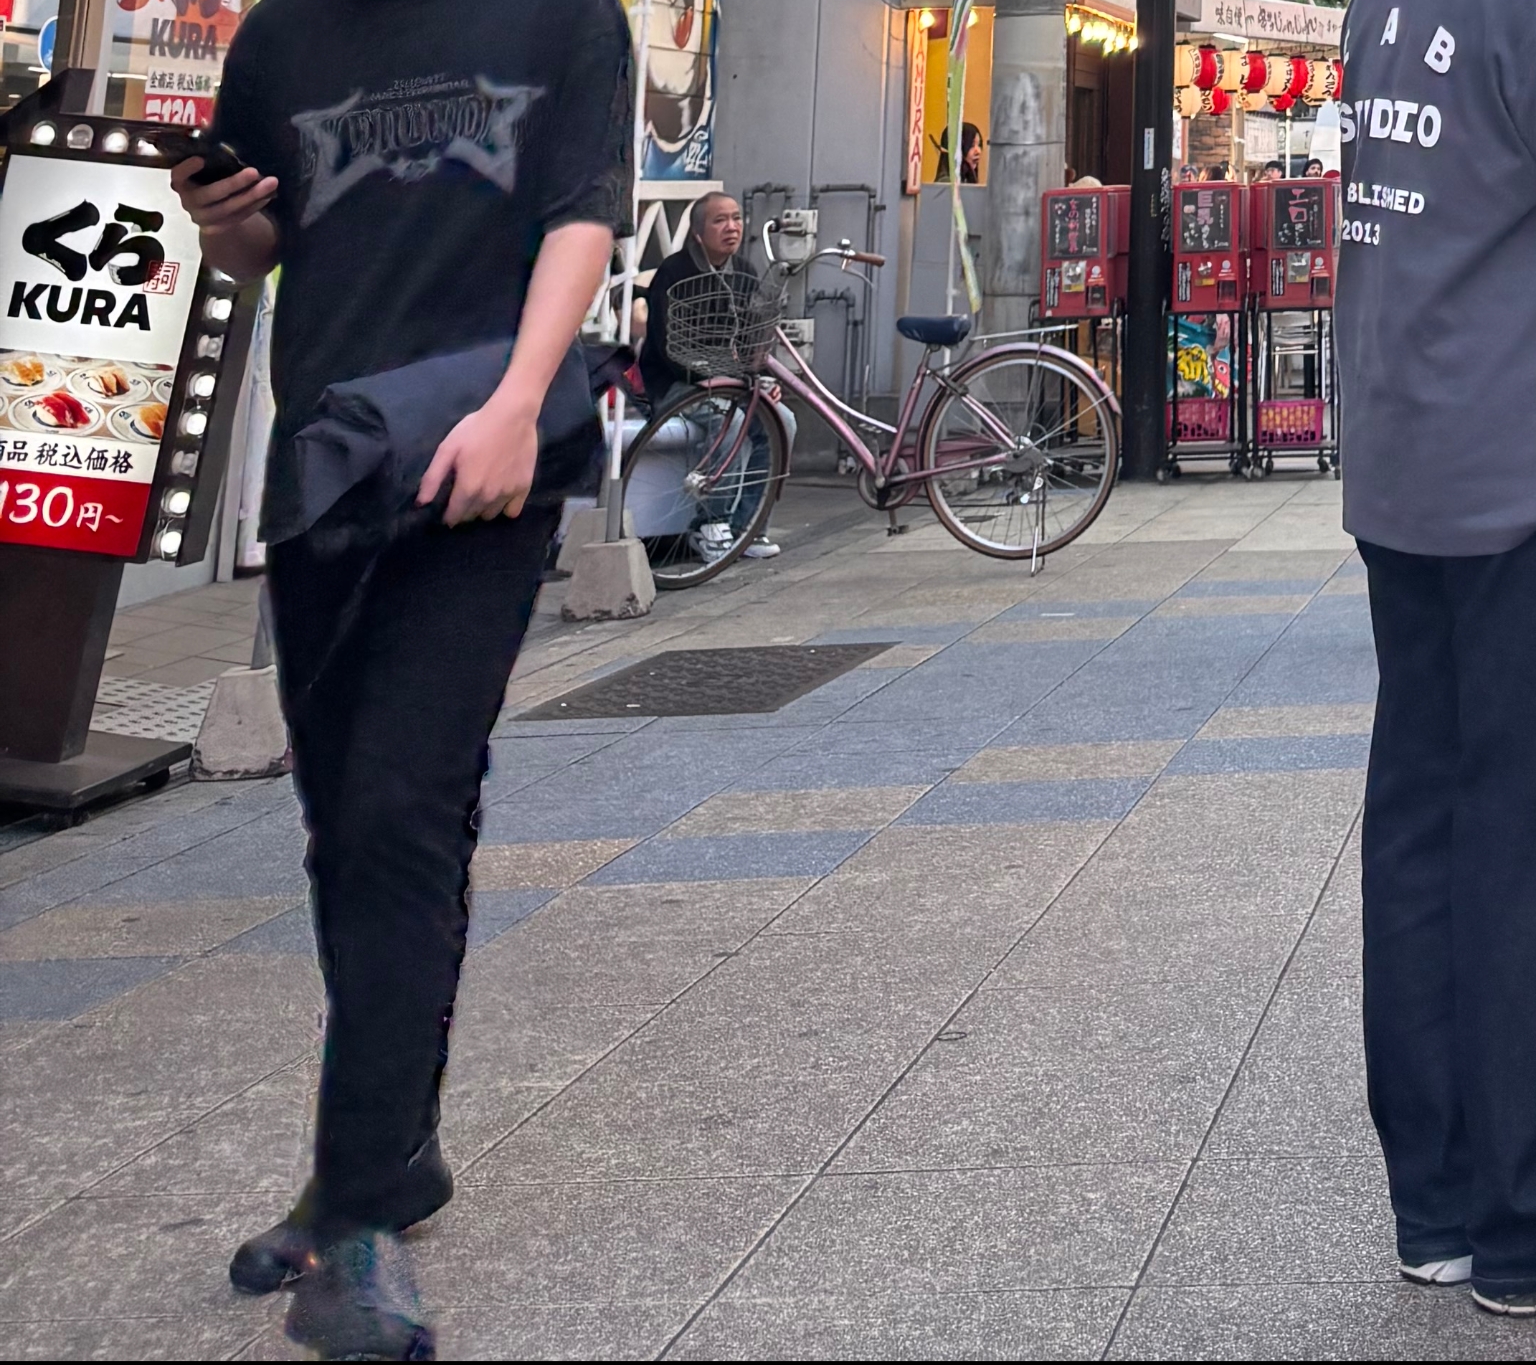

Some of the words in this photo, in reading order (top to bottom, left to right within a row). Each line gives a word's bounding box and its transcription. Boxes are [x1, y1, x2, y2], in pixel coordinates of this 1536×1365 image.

[149, 19, 218, 61] KURA
[149, 72, 174, 89] 全商品
[22, 198, 165, 286] くら
[1342, 220, 1380, 245] 2013
[7, 281, 151, 331] KURA
[34, 441, 133, 475] 税込価格
